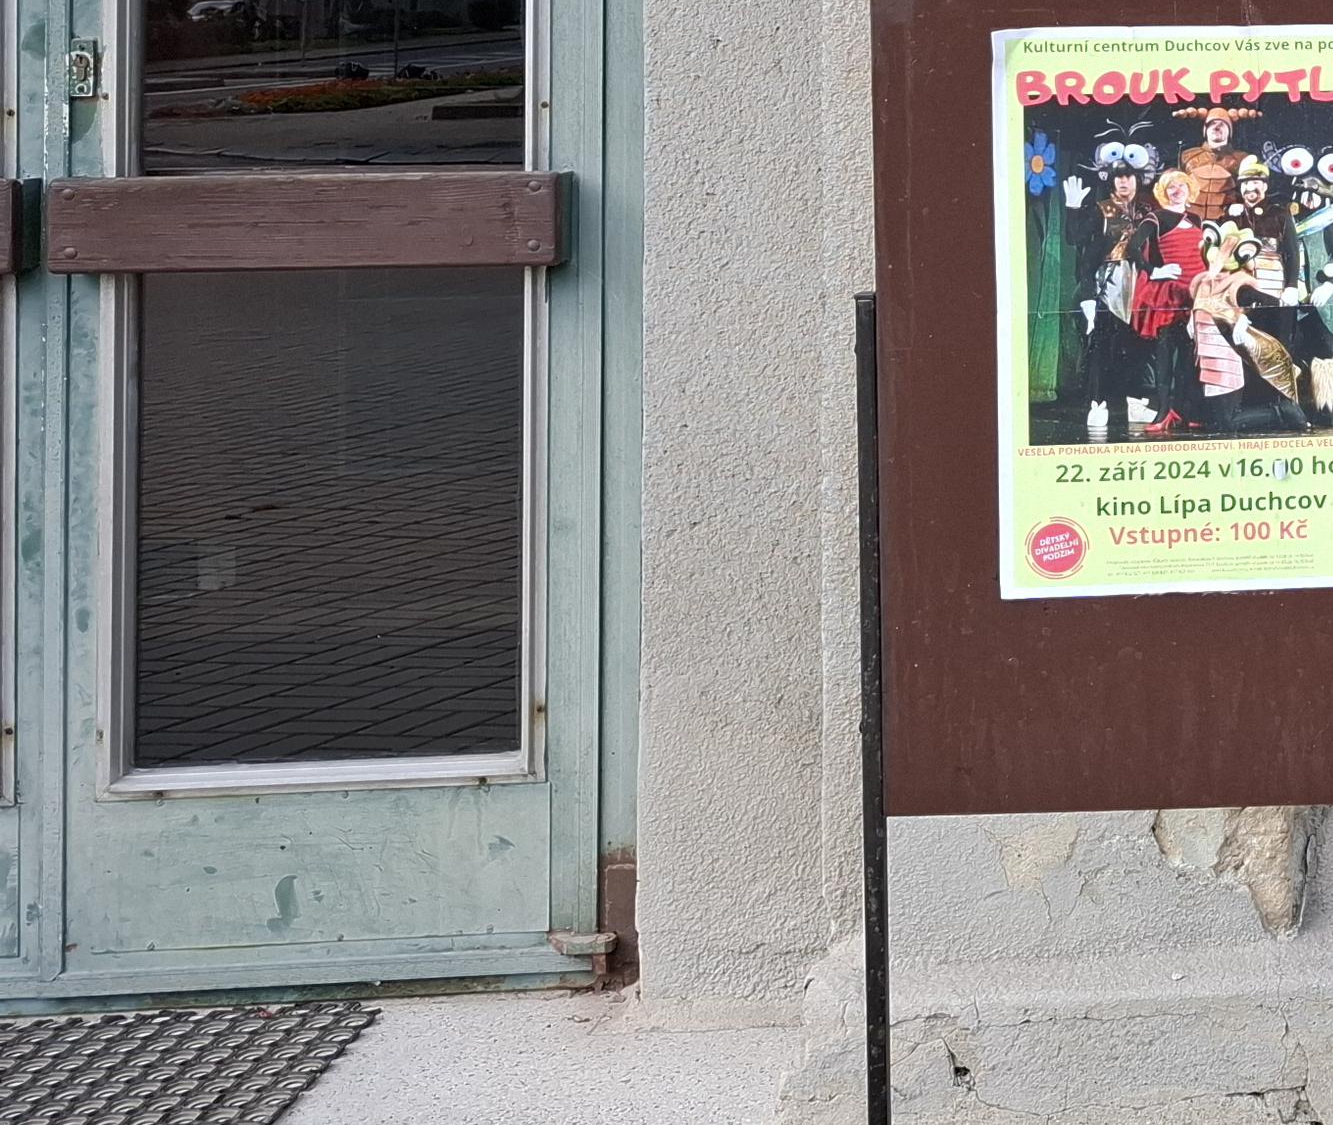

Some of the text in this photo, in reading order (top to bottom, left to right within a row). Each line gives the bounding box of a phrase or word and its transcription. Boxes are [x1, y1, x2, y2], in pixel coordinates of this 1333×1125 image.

[1023, 40, 1088, 53] Kulturní
[1093, 41, 1159, 52] centrum
[1165, 39, 1230, 52] Duchcov
[1234, 38, 1260, 51] Vás
[1265, 41, 1290, 50] zve
[1295, 40, 1313, 50] na
[1016, 67, 1196, 107] BROUK
[1238, 441, 1270, 451] HRAJE
[1272, 439, 1314, 449] DOCELA
[1055, 464, 1091, 483] 22.
[1098, 461, 1148, 482] září
[1153, 460, 1211, 480] 2024
[1218, 463, 1231, 477] v
[1096, 491, 1328, 519] kino Lípa Duchcov
[1109, 518, 1308, 549] Vstupné: 100 Kč
